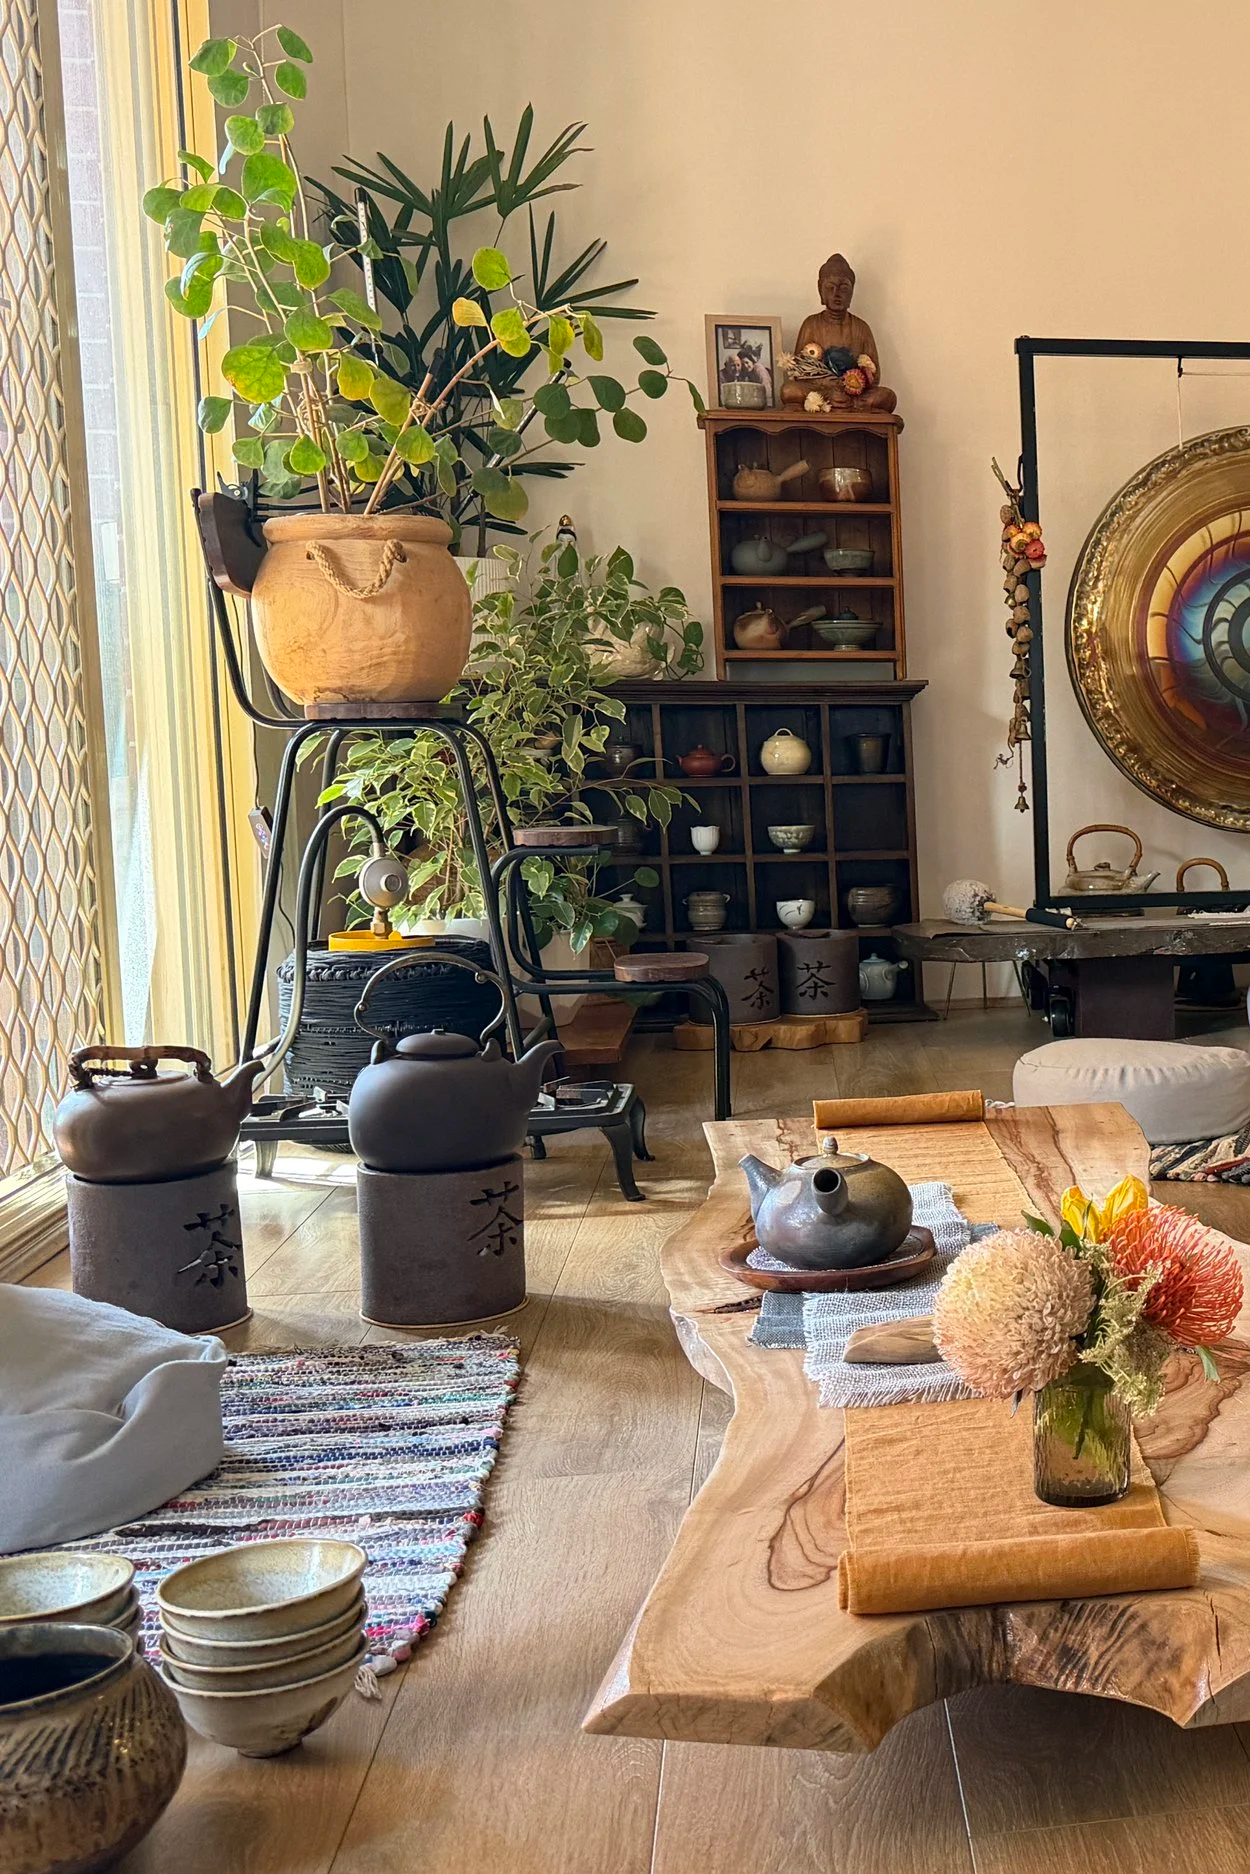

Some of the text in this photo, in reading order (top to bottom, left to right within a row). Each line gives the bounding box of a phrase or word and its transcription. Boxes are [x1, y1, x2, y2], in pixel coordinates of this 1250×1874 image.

[741, 965, 774, 1010] 茶
[795, 960, 836, 1001] 茶
[177, 1203, 243, 1289] 茶
[468, 1180, 526, 1257] 茶
